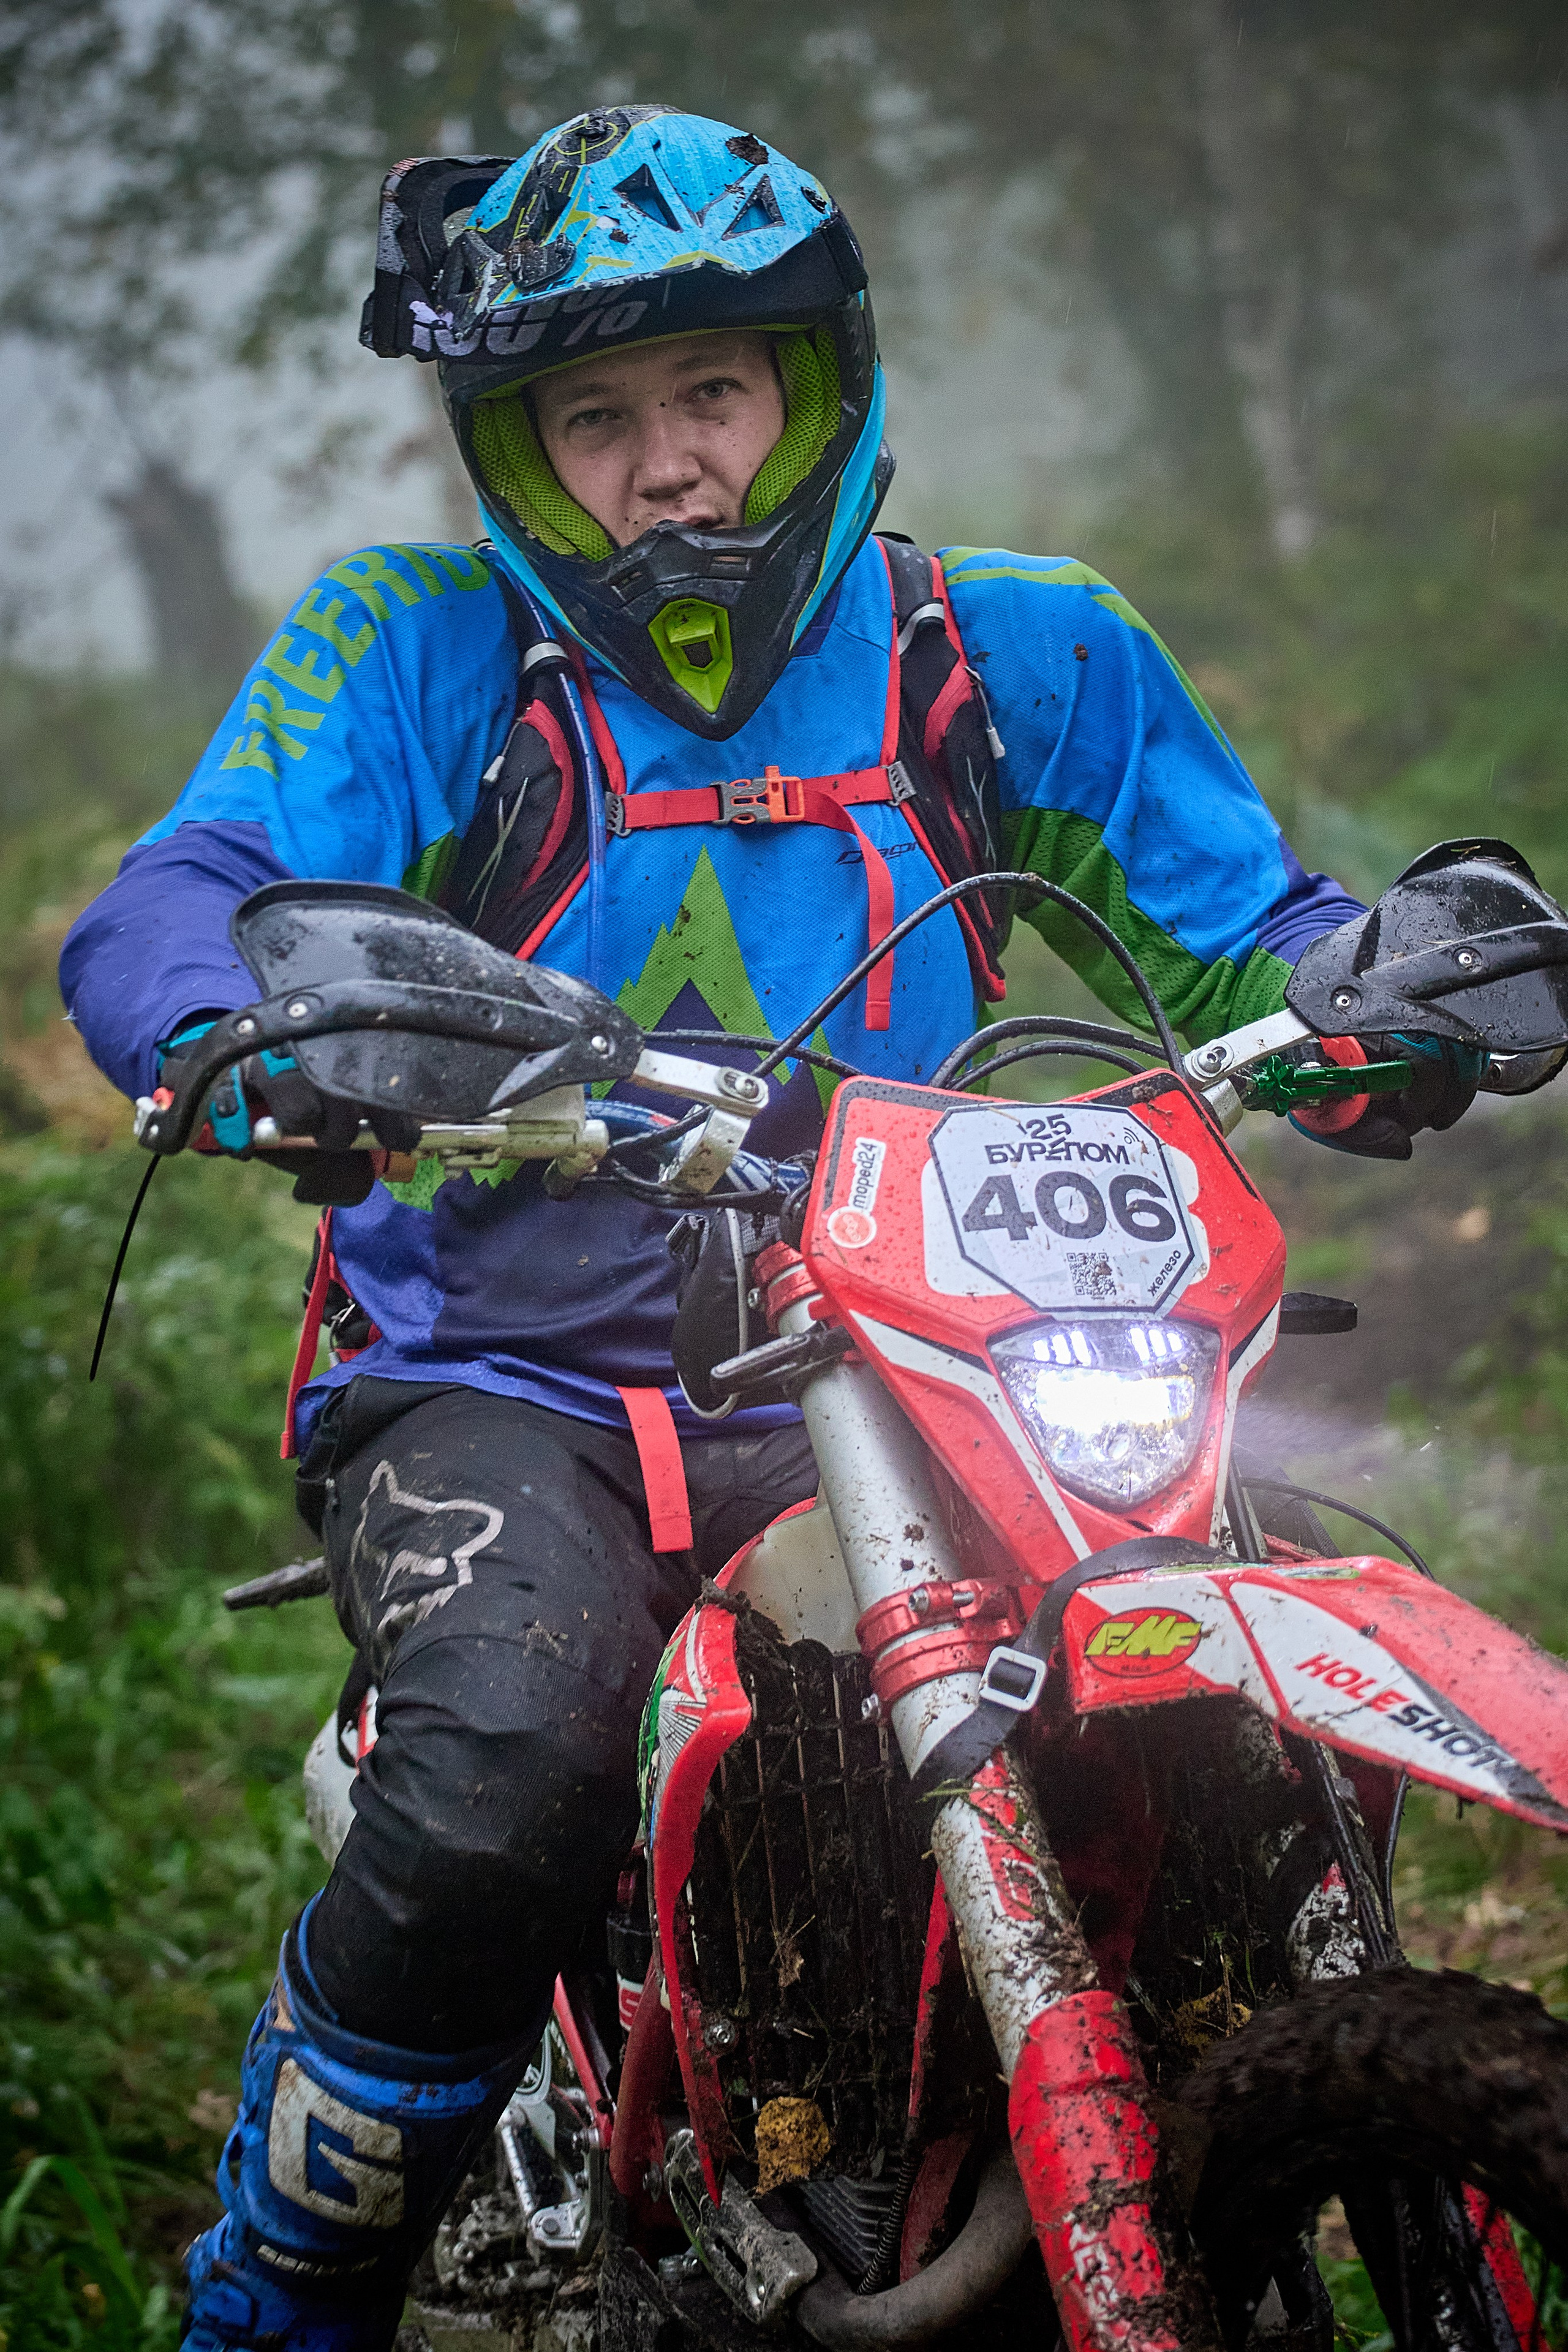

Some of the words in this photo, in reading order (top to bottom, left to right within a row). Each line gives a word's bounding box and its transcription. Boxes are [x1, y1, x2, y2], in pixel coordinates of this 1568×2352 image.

[1025, 1113, 1072, 1140] 25
[853, 1141, 877, 1209] moped24
[961, 1170, 1177, 1242] 406
[1084, 1615, 1203, 1657] FMF
